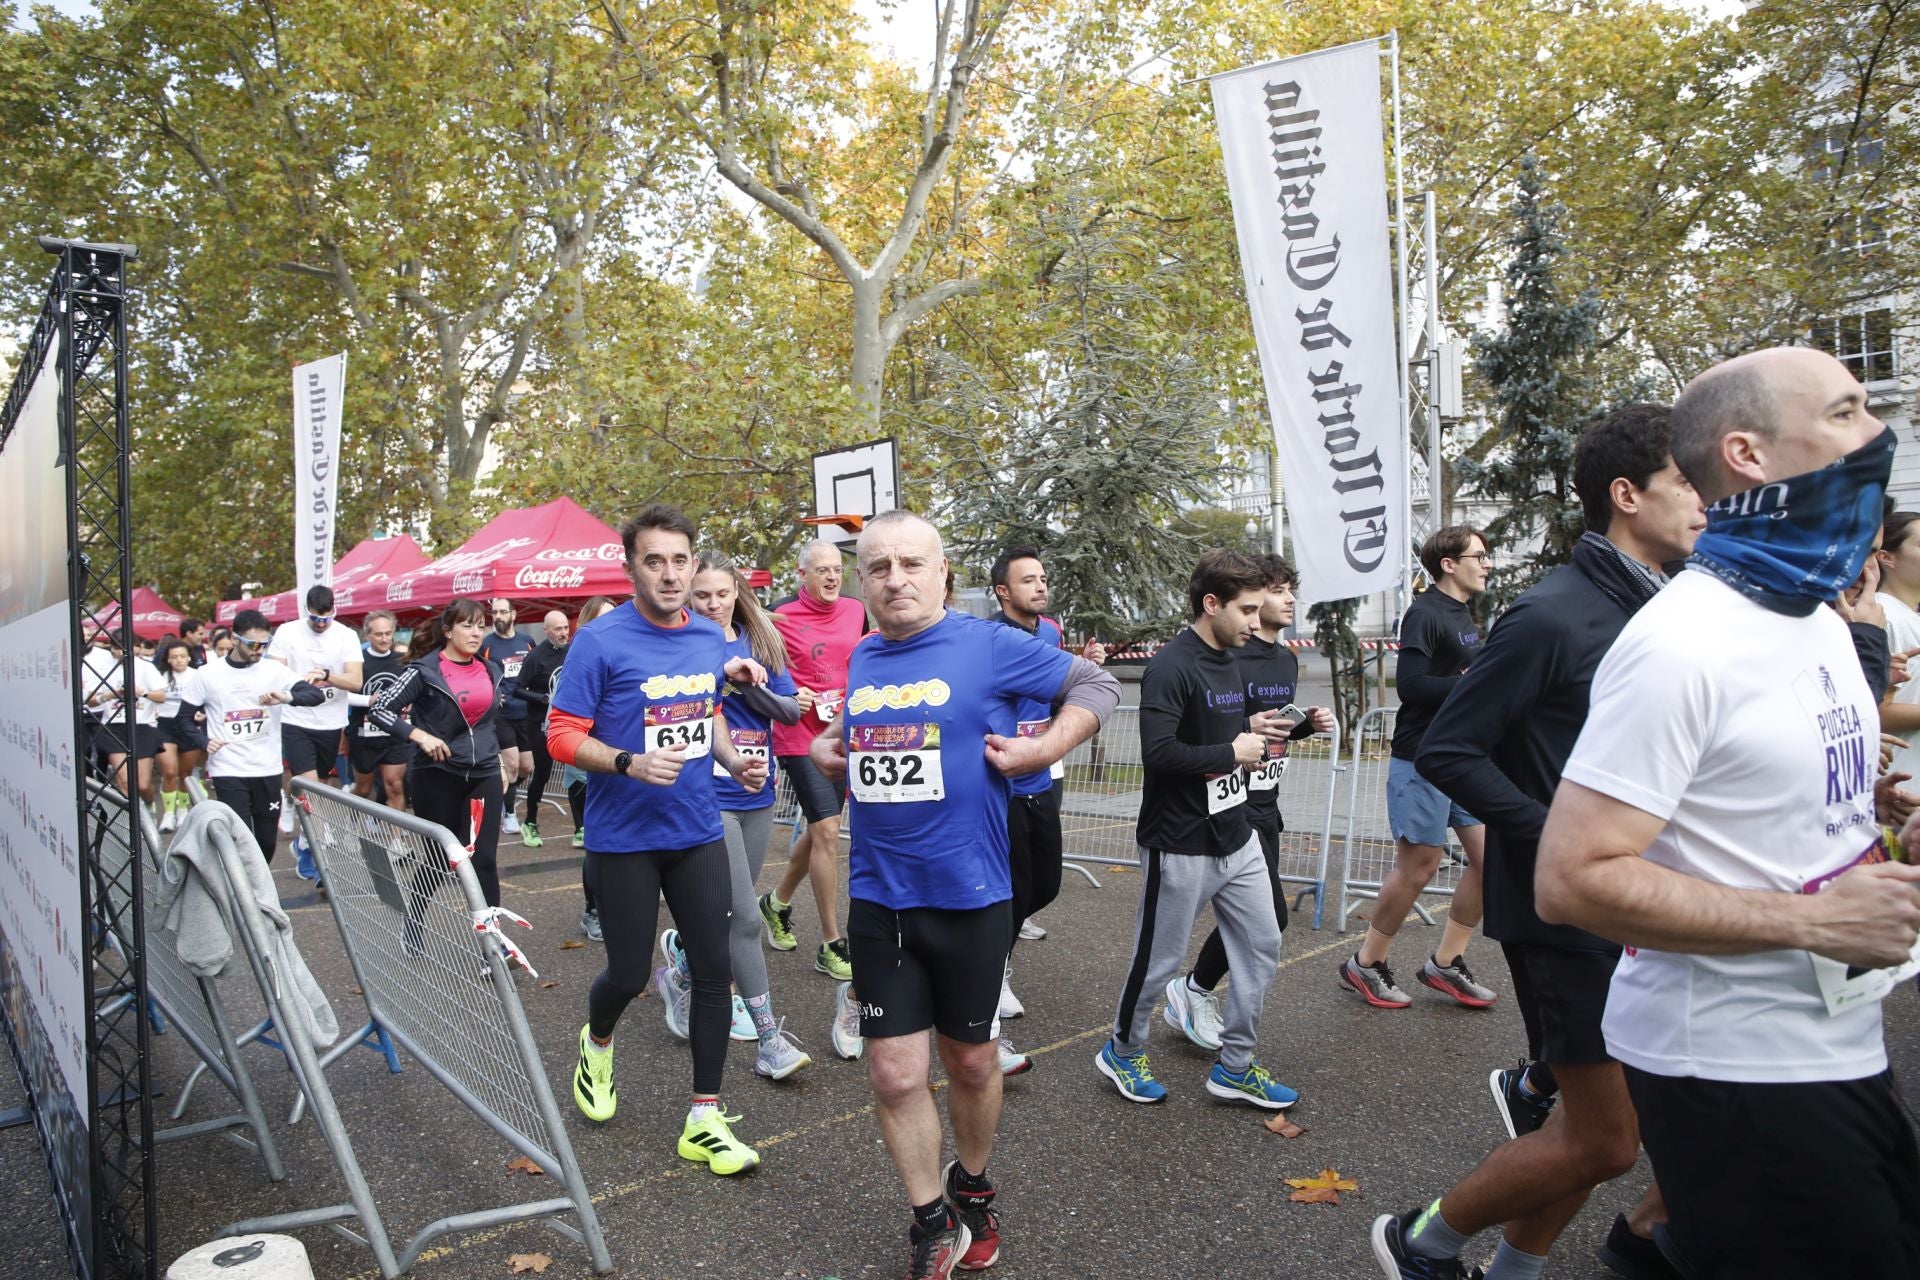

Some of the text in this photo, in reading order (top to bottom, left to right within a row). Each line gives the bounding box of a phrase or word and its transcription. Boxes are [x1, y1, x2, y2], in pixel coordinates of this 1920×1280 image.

[231, 721, 264, 735] 917
[657, 722, 706, 749] 634
[1817, 704, 1862, 743] PUCELA
[859, 755, 925, 787] 632
[1826, 736, 1865, 806] RUN
